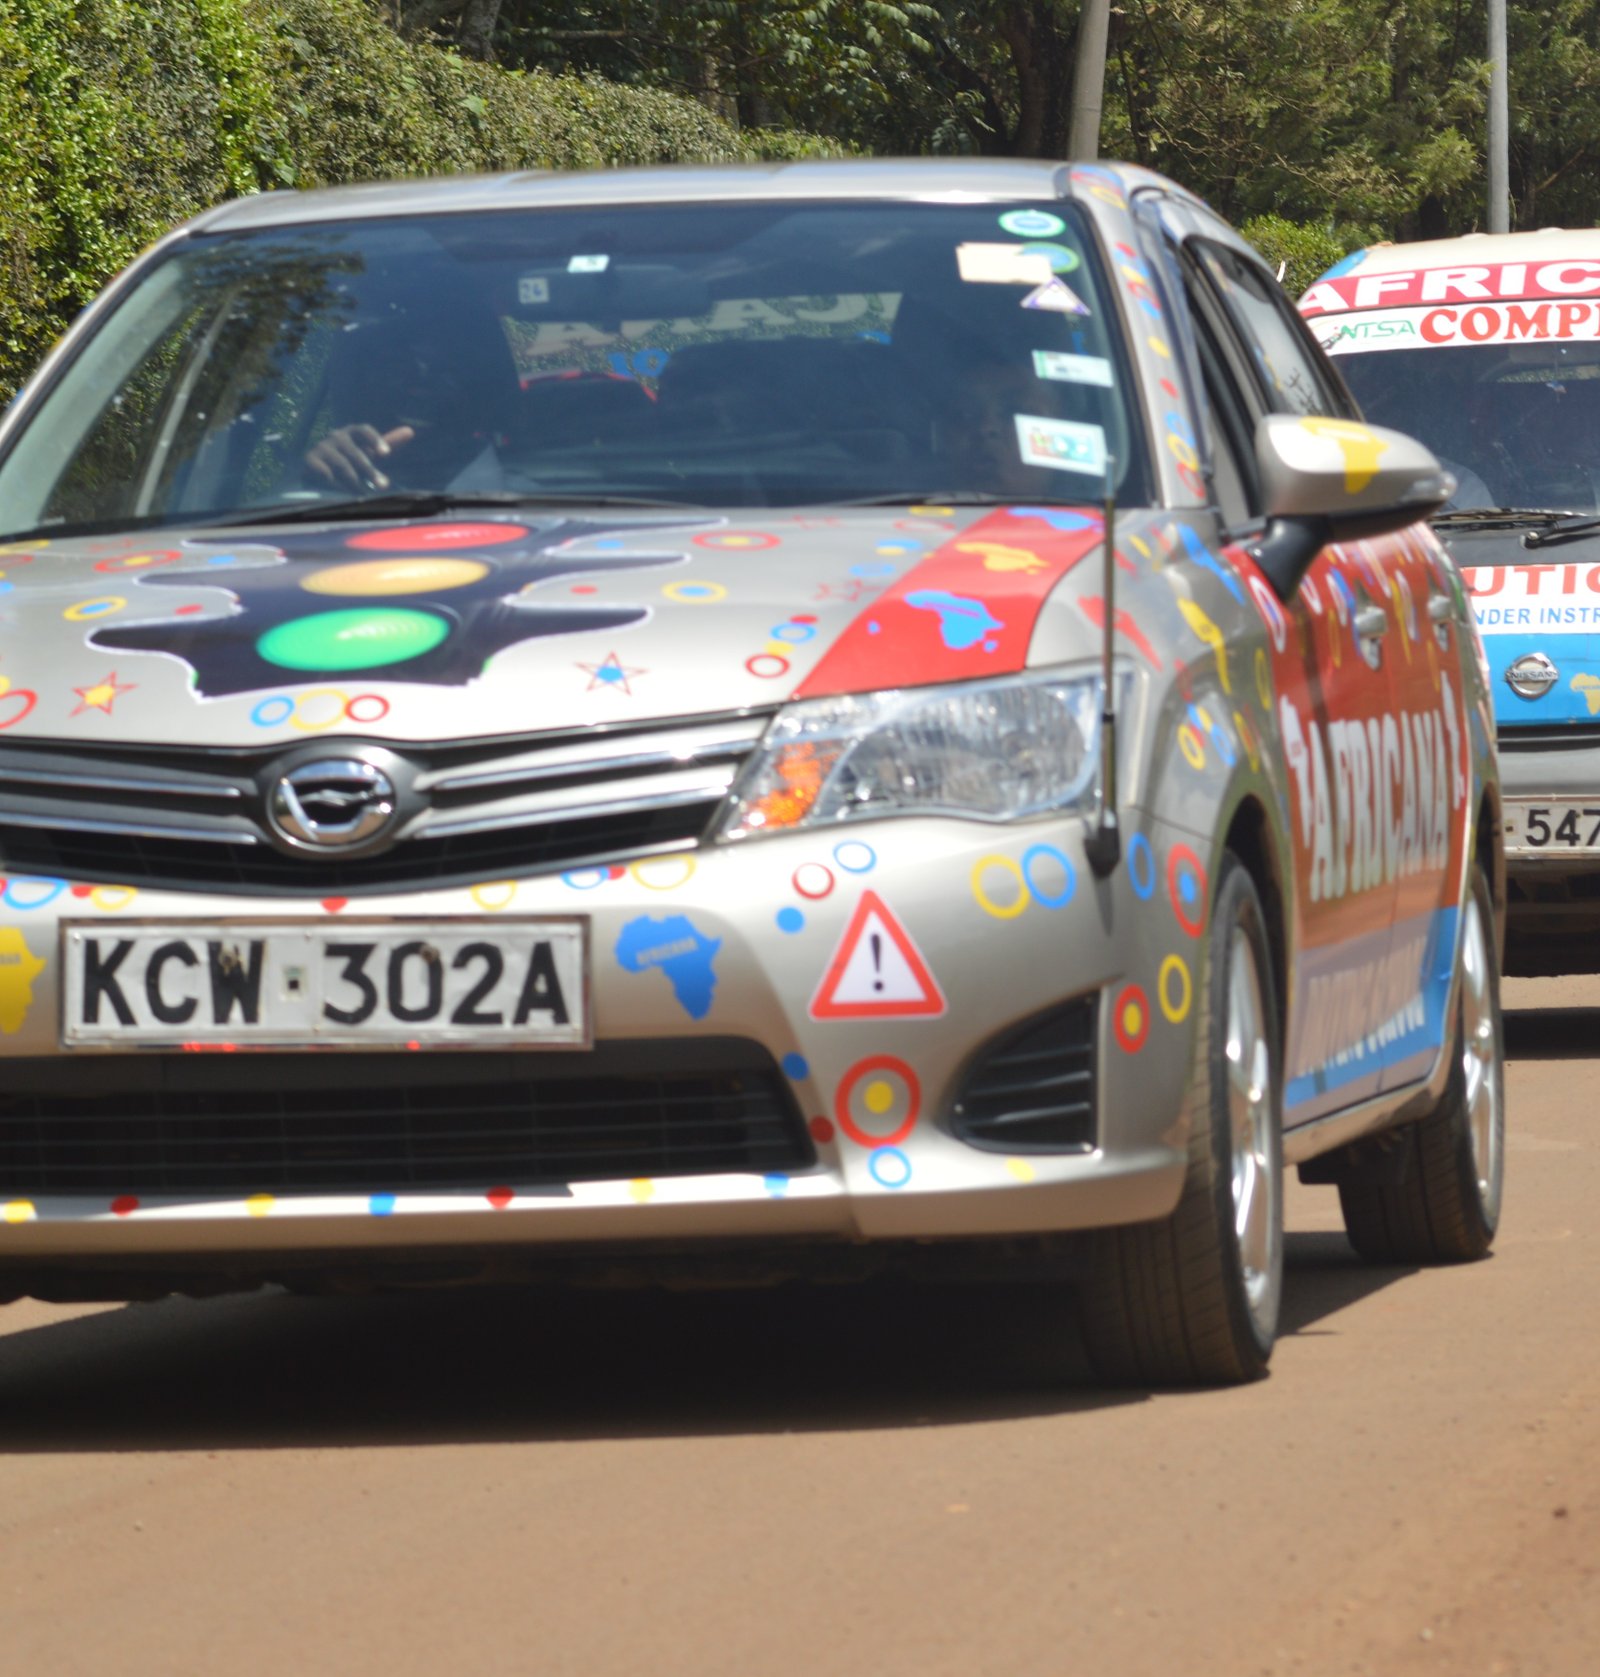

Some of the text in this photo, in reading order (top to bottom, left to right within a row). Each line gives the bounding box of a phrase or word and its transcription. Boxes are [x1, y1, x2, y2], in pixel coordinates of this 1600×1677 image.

[1300, 261, 1600, 314] AFRIC
[1340, 302, 1600, 343] NTSA COMP
[1309, 710, 1448, 902] AFRICANA
[1525, 808, 1600, 847] 547
[82, 938, 571, 1026] KCW 302A
